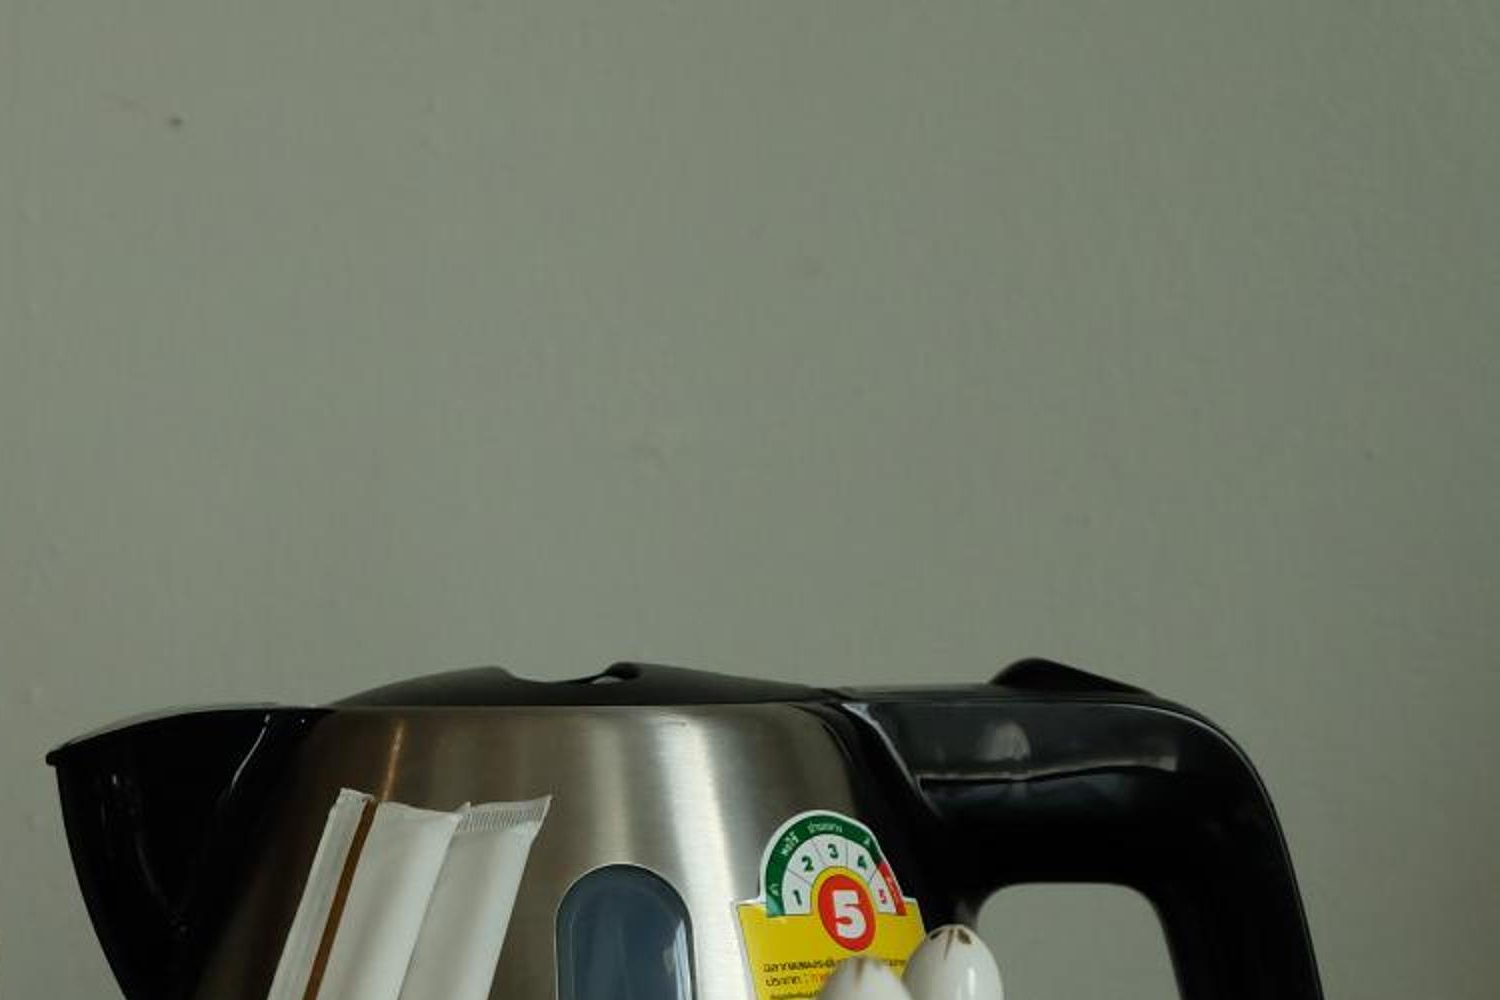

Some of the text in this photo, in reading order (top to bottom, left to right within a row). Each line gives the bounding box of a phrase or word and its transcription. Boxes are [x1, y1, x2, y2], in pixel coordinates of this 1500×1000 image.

[827, 843, 839, 859] 3
[801, 855, 814, 872] 2
[857, 855, 868, 870] 4
[793, 889, 802, 906] 1
[832, 889, 867, 939] 5
